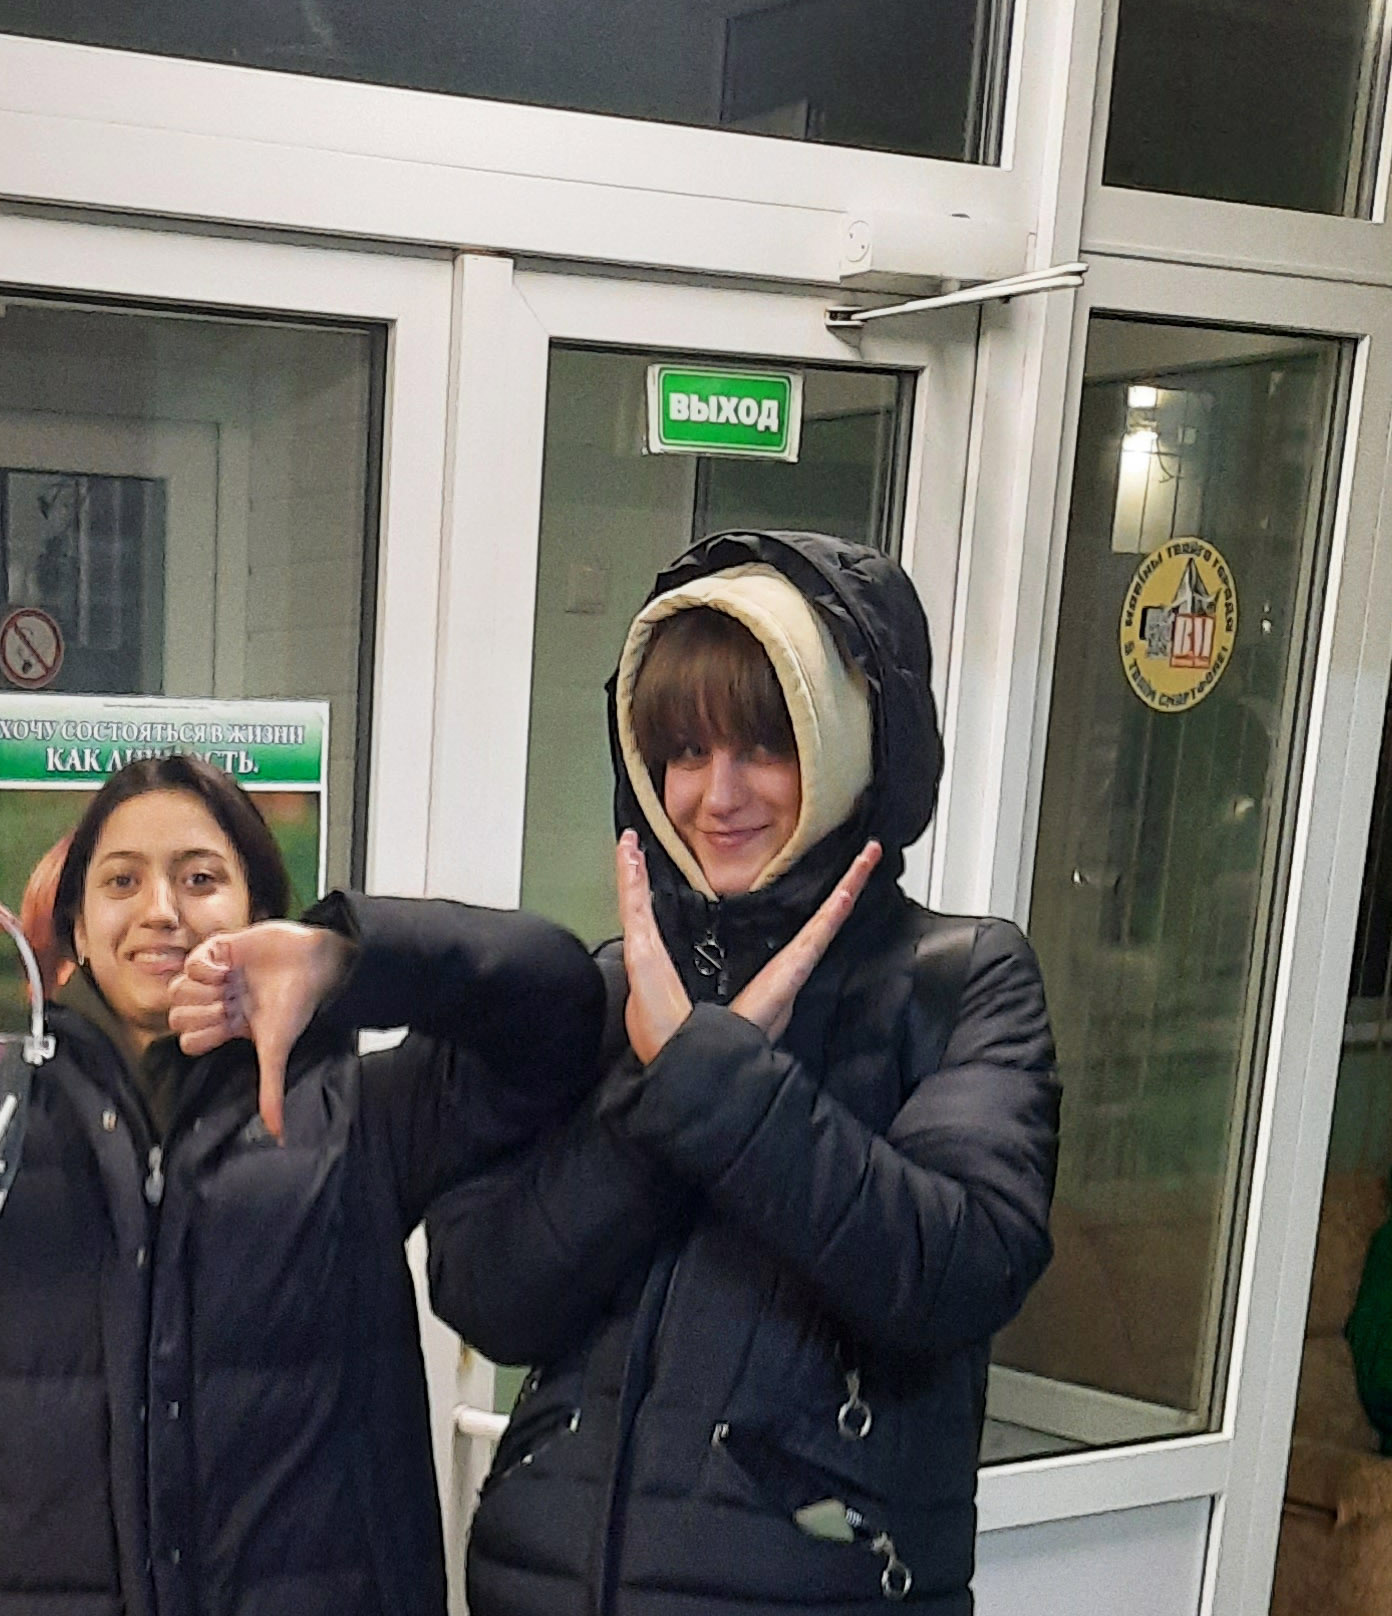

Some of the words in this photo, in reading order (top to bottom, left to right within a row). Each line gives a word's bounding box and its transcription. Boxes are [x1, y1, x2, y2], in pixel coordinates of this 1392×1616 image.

[669, 392, 779, 433] ВЫХОД
[61, 719, 208, 744] СОСТОЯТЬСЯ
[210, 723, 224, 744] В
[226, 724, 305, 745] ЖИЗНИ
[45, 747, 103, 773] КАК
